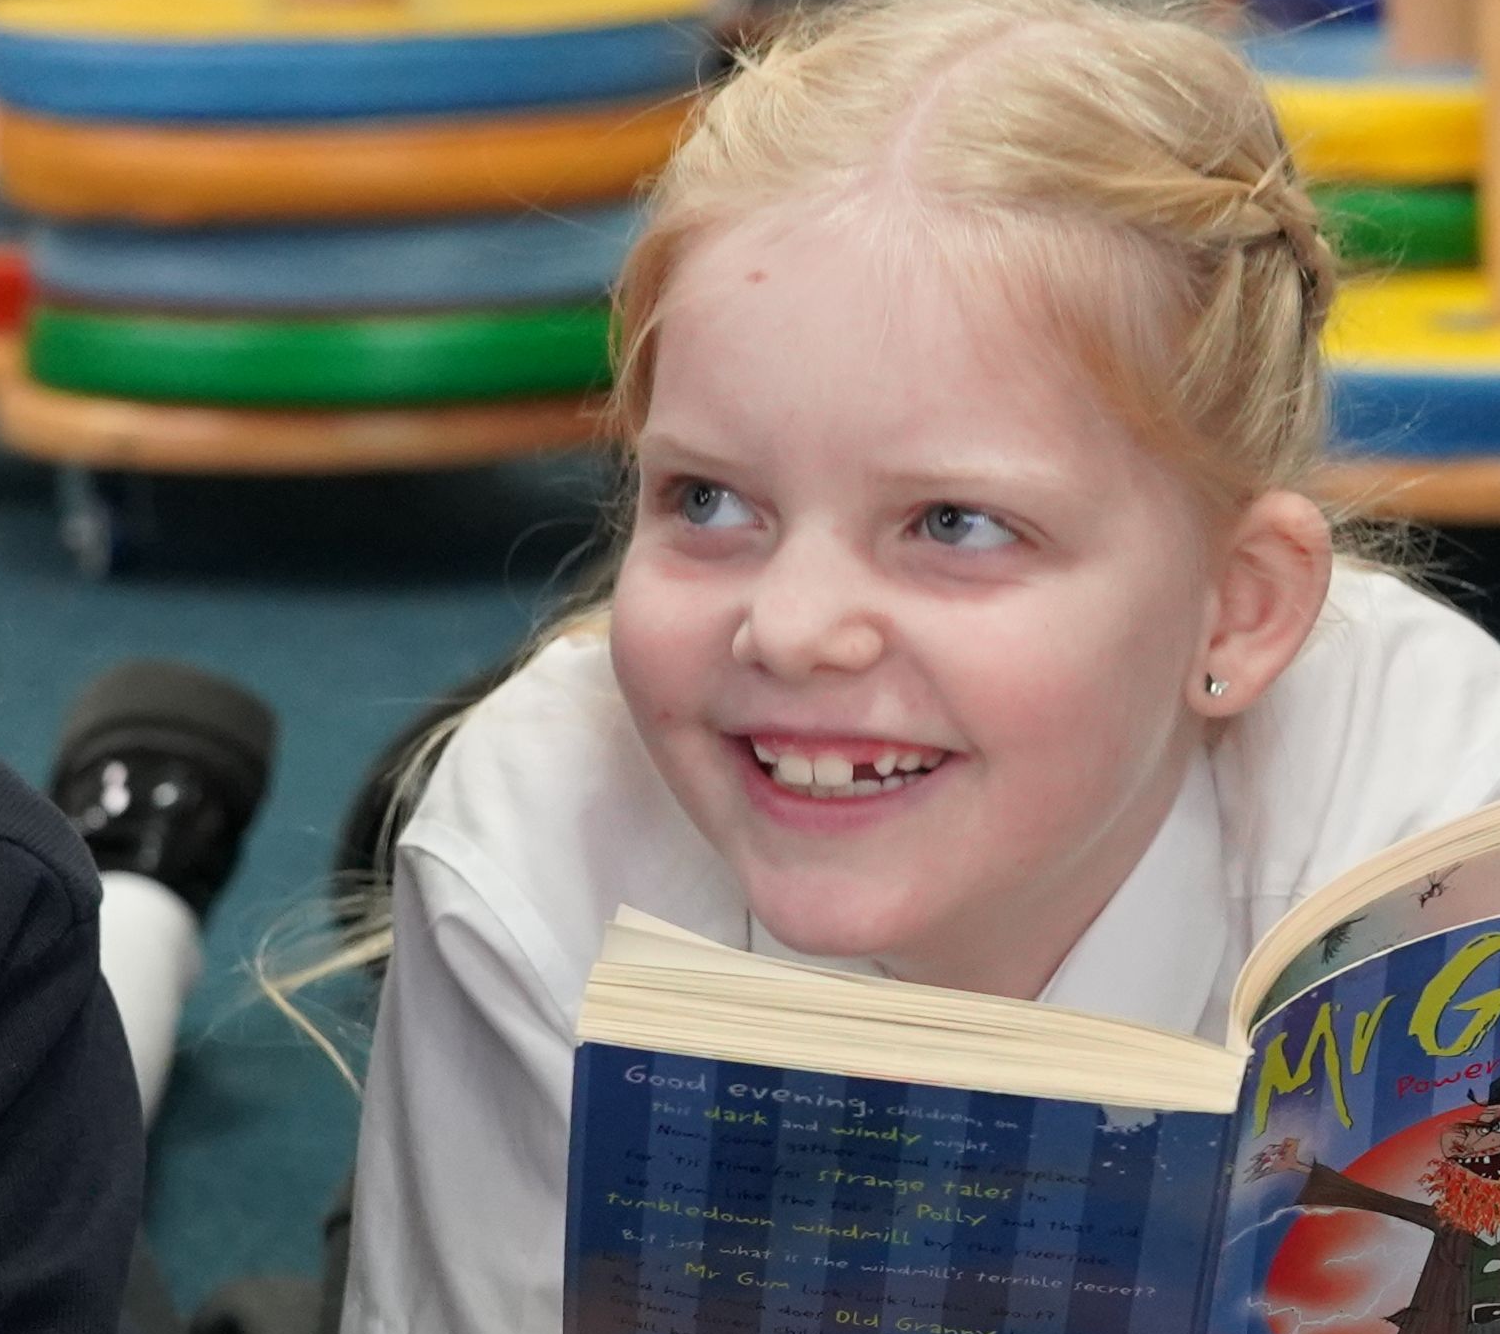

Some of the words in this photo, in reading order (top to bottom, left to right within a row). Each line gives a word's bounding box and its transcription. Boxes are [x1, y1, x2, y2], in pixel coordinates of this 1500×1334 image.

[1253, 994, 1397, 1138] Mr
[625, 1065, 707, 1093] Good
[727, 1083, 874, 1117] evening,
[886, 1106, 983, 1128] children,
[993, 1120, 1019, 1129] on
[652, 1101, 691, 1116] this
[704, 1106, 770, 1126] dark
[780, 1119, 819, 1132] and
[828, 1120, 922, 1146] windy
[932, 1138, 996, 1154] night.
[657, 1123, 708, 1141] Now,
[717, 1134, 775, 1147] come
[625, 1176, 649, 1188] be
[663, 1181, 707, 1194] spun
[725, 1187, 767, 1202] like
[780, 1193, 817, 1208] the
[916, 1203, 987, 1228] Polly
[1002, 1218, 1036, 1229] and
[773, 1164, 801, 1178] for
[816, 1166, 925, 1196] strange
[941, 1180, 1012, 1200] tales
[1027, 1191, 1048, 1203] to
[605, 1191, 776, 1227] tumbledown
[791, 1223, 913, 1247] windmill
[923, 1236, 953, 1251] by
[621, 1229, 657, 1244] But
[666, 1233, 708, 1251] just
[719, 1244, 773, 1260] what
[784, 1252, 799, 1263] is
[812, 1256, 849, 1267] the
[859, 1261, 964, 1281] windmill's
[976, 1271, 1064, 1289] terrible
[1074, 1282, 1157, 1300] secret?
[683, 1261, 721, 1280] Mr
[736, 1271, 791, 1291] Gum
[778, 1303, 825, 1320] does
[835, 1309, 881, 1329] Old
